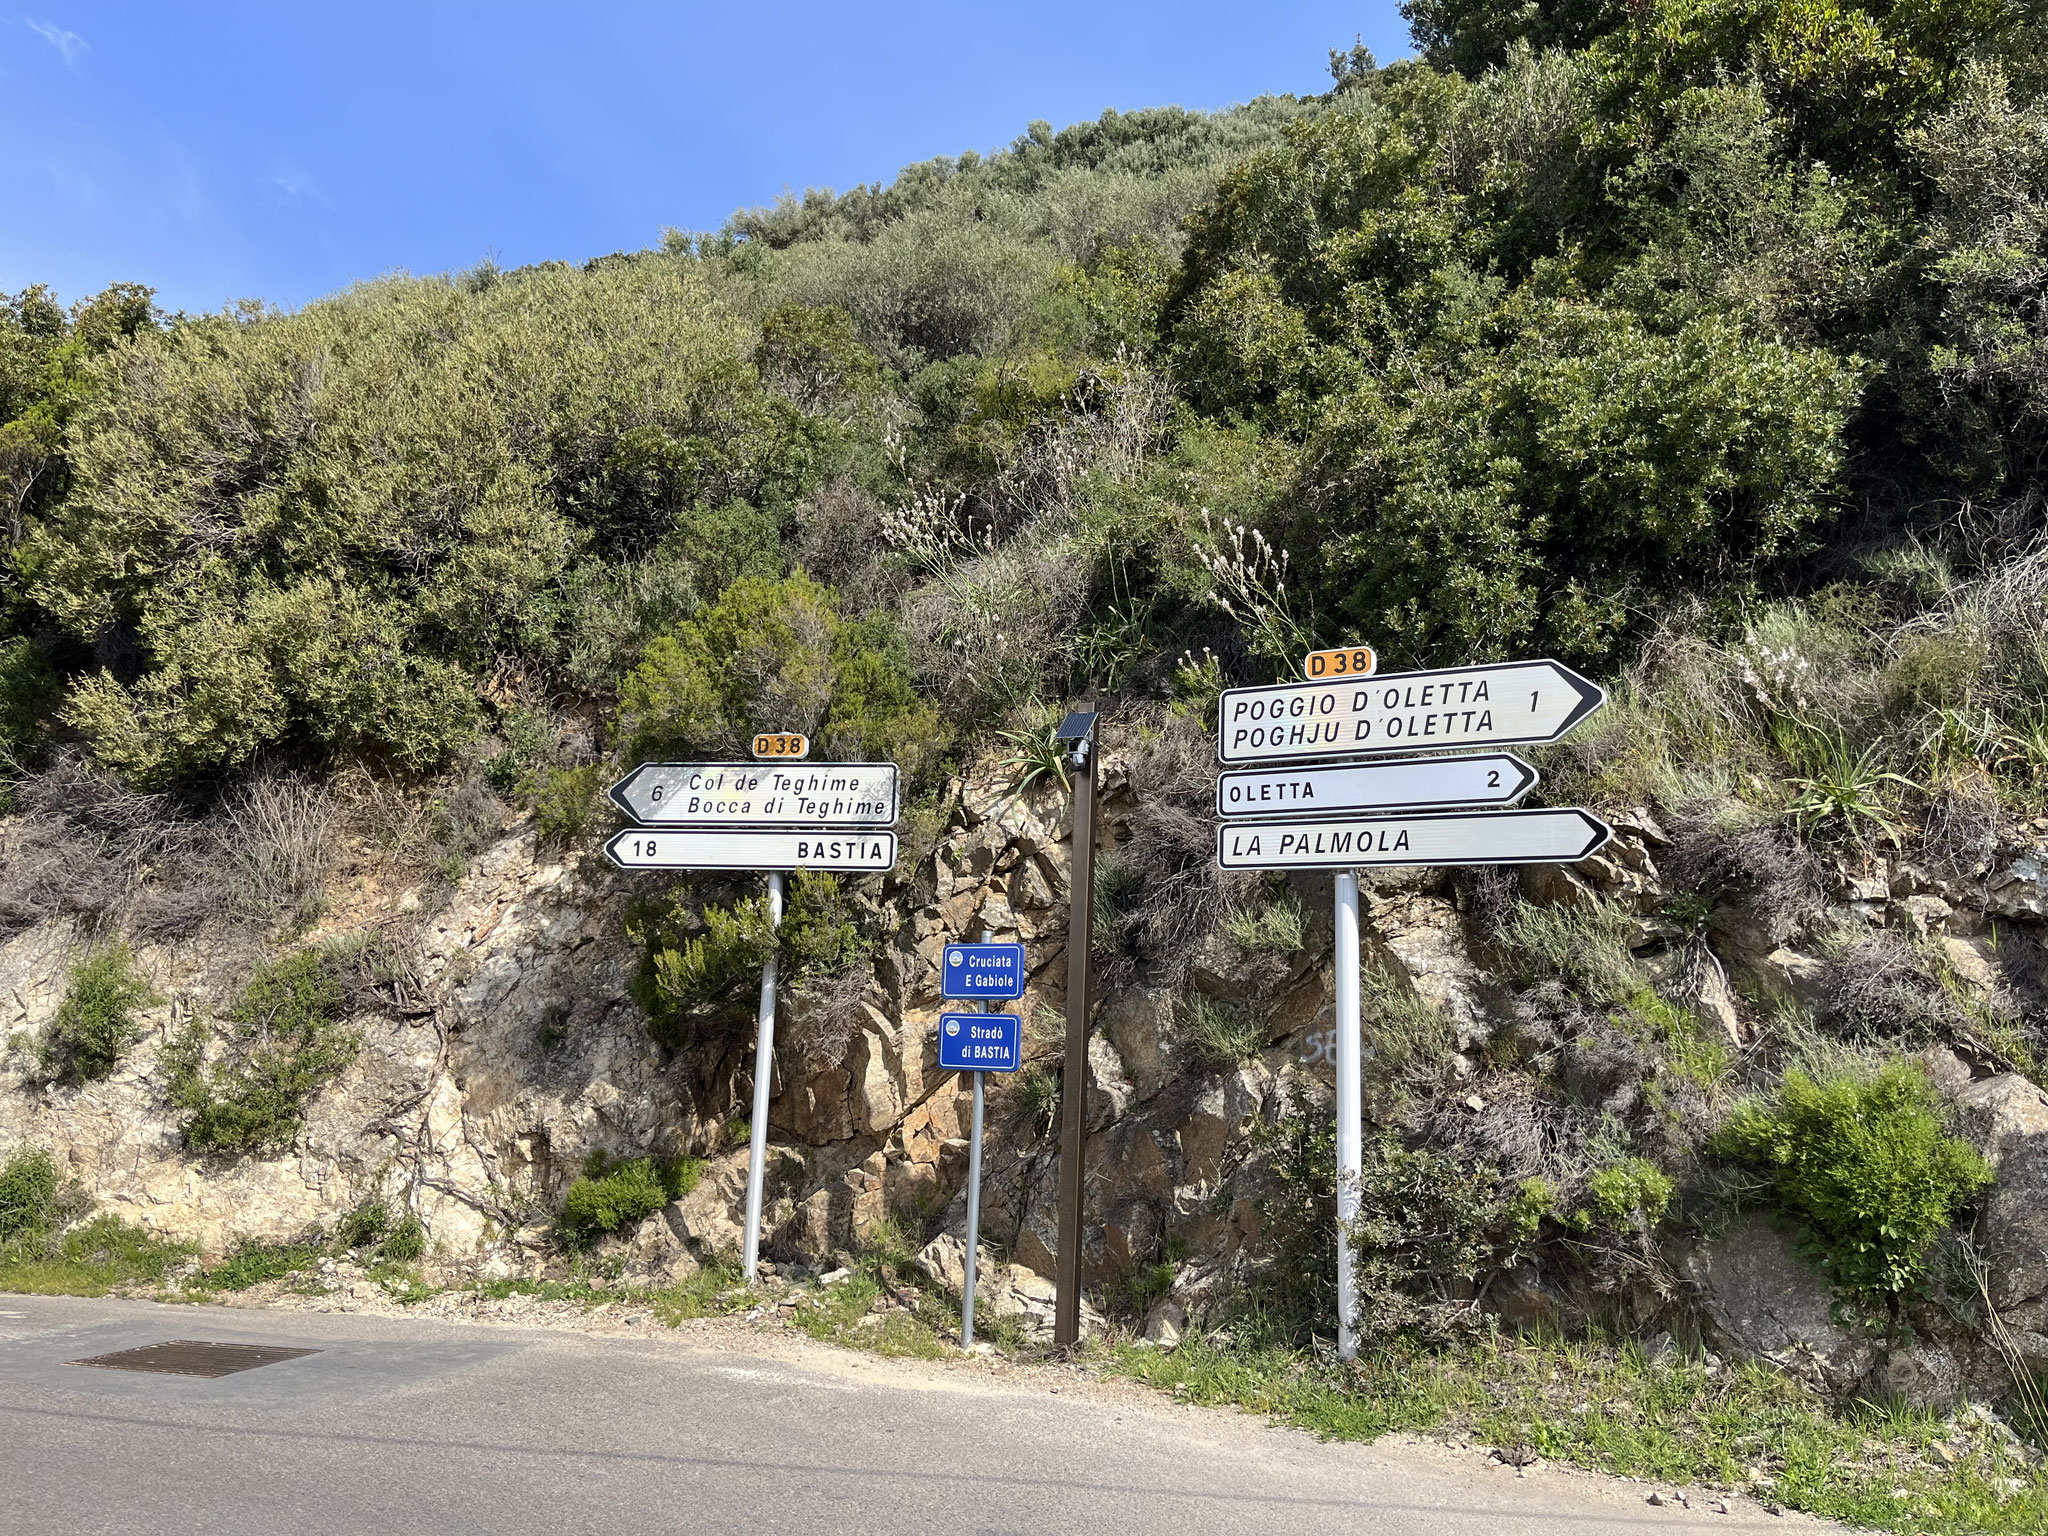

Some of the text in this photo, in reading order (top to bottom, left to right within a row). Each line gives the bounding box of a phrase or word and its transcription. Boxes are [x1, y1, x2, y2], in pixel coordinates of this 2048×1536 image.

[1311, 651, 1367, 676] D 38
[1233, 680, 1490, 722] POGGIO D'OLETTA
[1529, 690, 1539, 713] 1
[1233, 709, 1494, 749] POGHJU D'OLETTA
[757, 737, 802, 754] D 38
[651, 786, 663, 802] 6
[689, 774, 860, 796] Col de Teghime
[1229, 770, 1500, 803] OLETTA 2
[688, 797, 886, 818] Bocca di Teghime
[633, 840, 883, 860] 18 BASTIA
[1232, 829, 1411, 856] LA PALMOLA
[968, 955, 1012, 968] Cruciata
[965, 974, 1014, 987] E Gabiole
[970, 1025, 1003, 1039] Stradò
[961, 1045, 1010, 1059] di BASTIA
